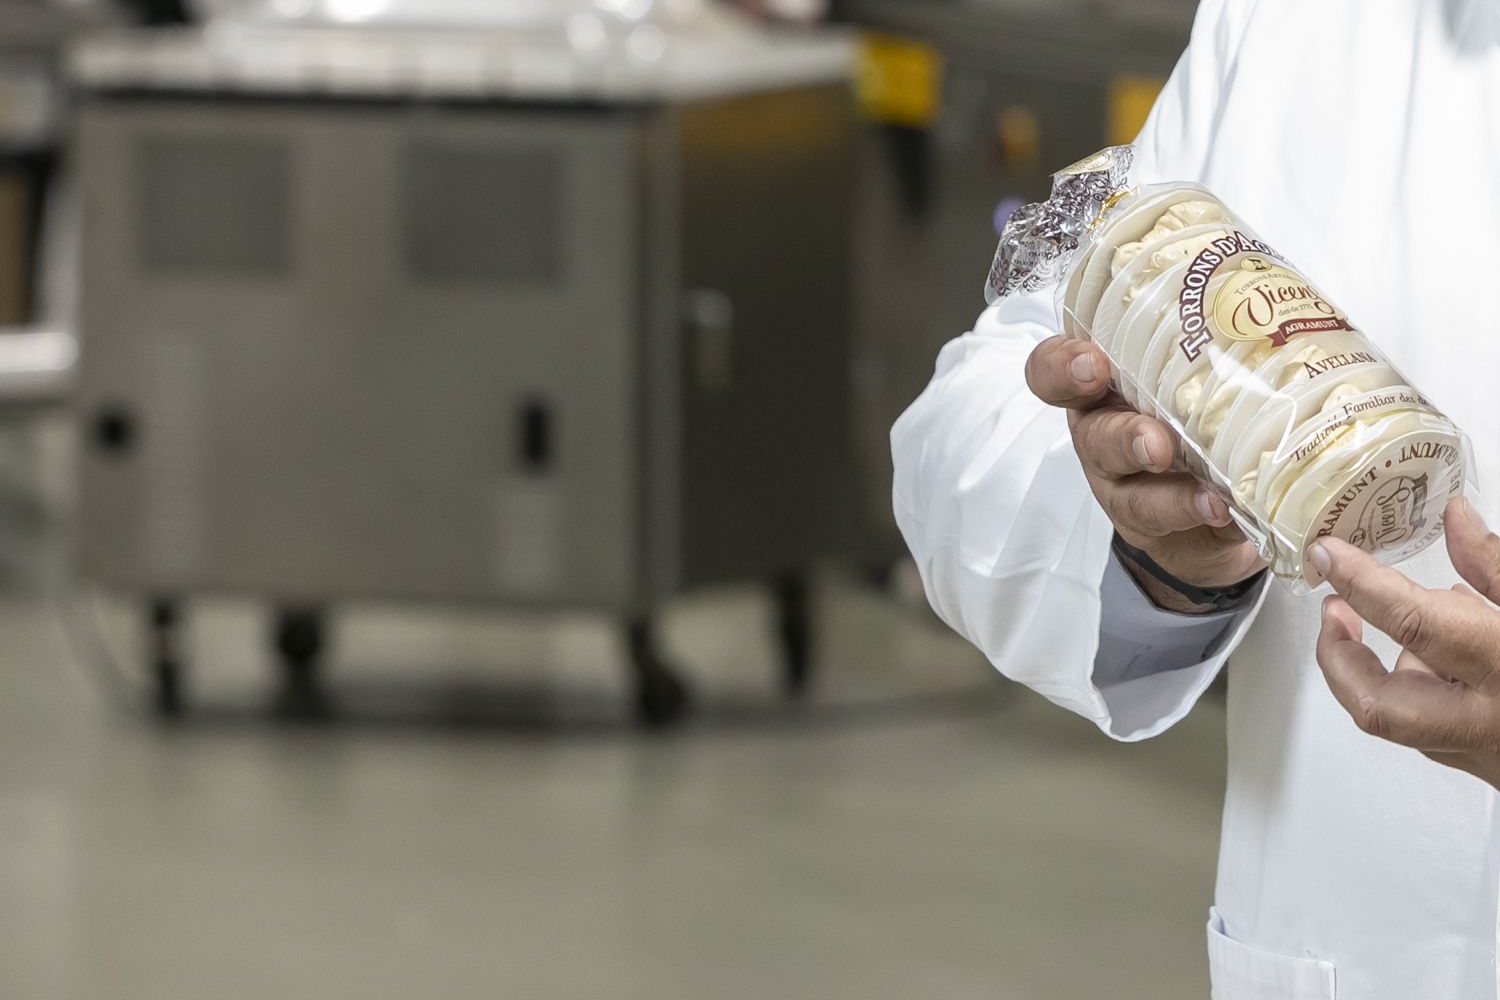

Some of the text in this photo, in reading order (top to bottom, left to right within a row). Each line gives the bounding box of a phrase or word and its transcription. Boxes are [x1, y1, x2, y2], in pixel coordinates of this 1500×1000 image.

[1179, 248, 1224, 363] TORRONS
[1284, 319, 1339, 335] AGRAMUNT
[1303, 352, 1377, 379] AVELLANA
[1342, 393, 1397, 420] Familiar
[1316, 467, 1378, 538] RAMUNT
